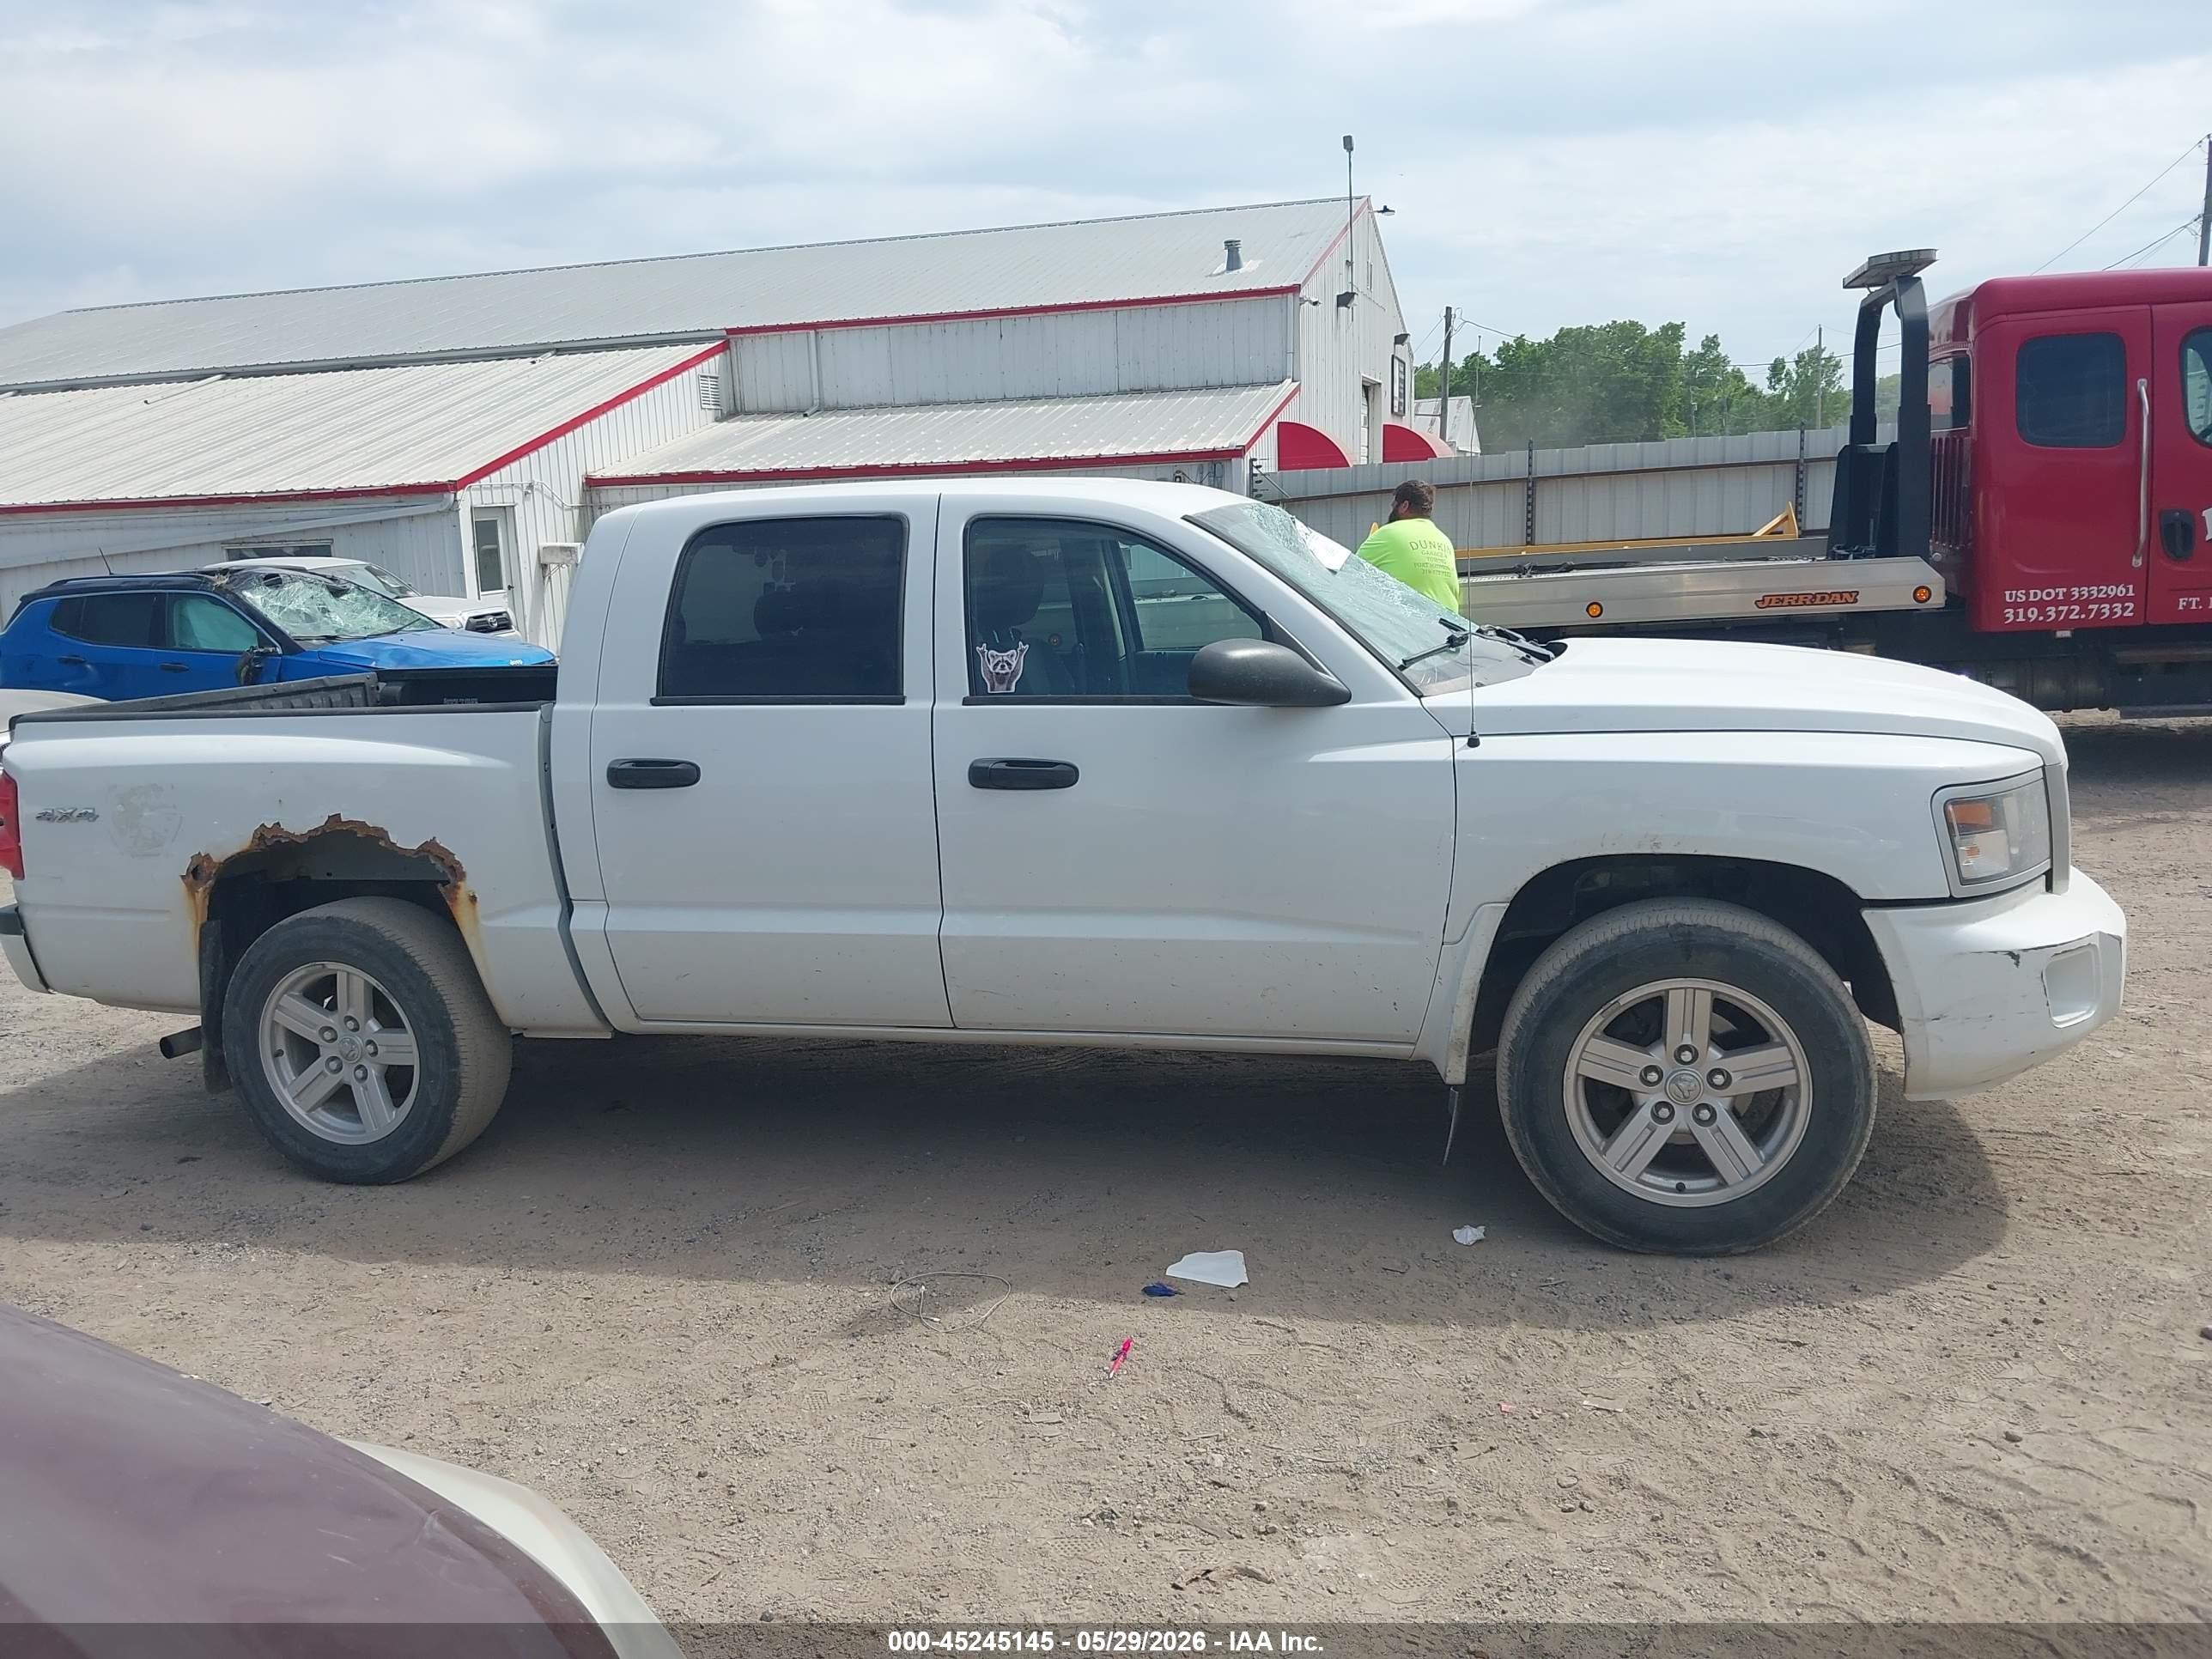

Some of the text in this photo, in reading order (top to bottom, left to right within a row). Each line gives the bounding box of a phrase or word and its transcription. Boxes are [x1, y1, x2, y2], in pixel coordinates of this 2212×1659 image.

[2004, 584, 2135, 602] US DOT 3332961
[2003, 602, 2135, 623] 319.372.7332
[2178, 597, 2203, 610] FT.
